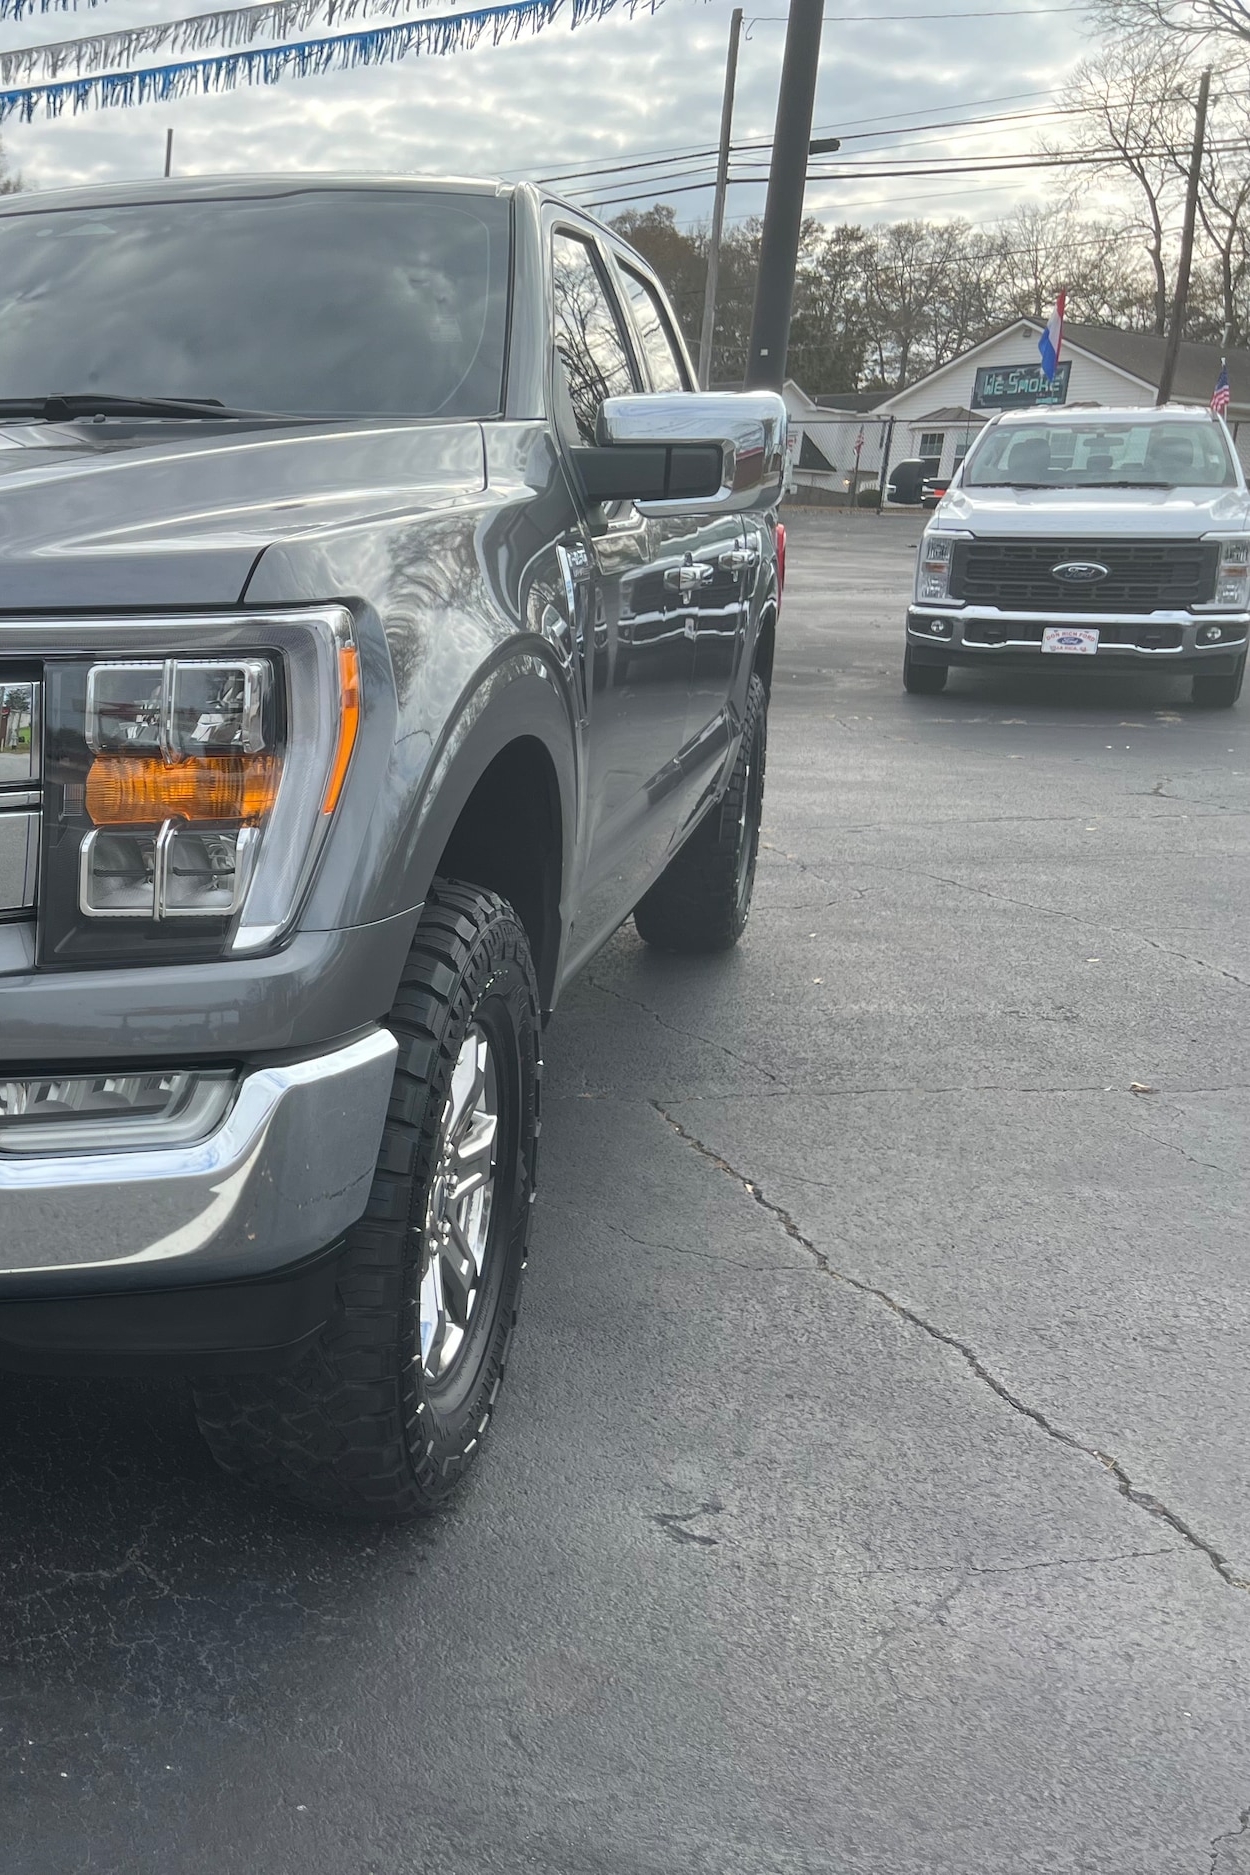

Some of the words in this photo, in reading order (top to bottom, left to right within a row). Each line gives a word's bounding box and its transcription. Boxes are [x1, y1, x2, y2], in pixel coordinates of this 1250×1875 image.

[1064, 566, 1095, 578] Ford
[1046, 632, 1060, 641] DON
[1079, 632, 1095, 642] FORD
